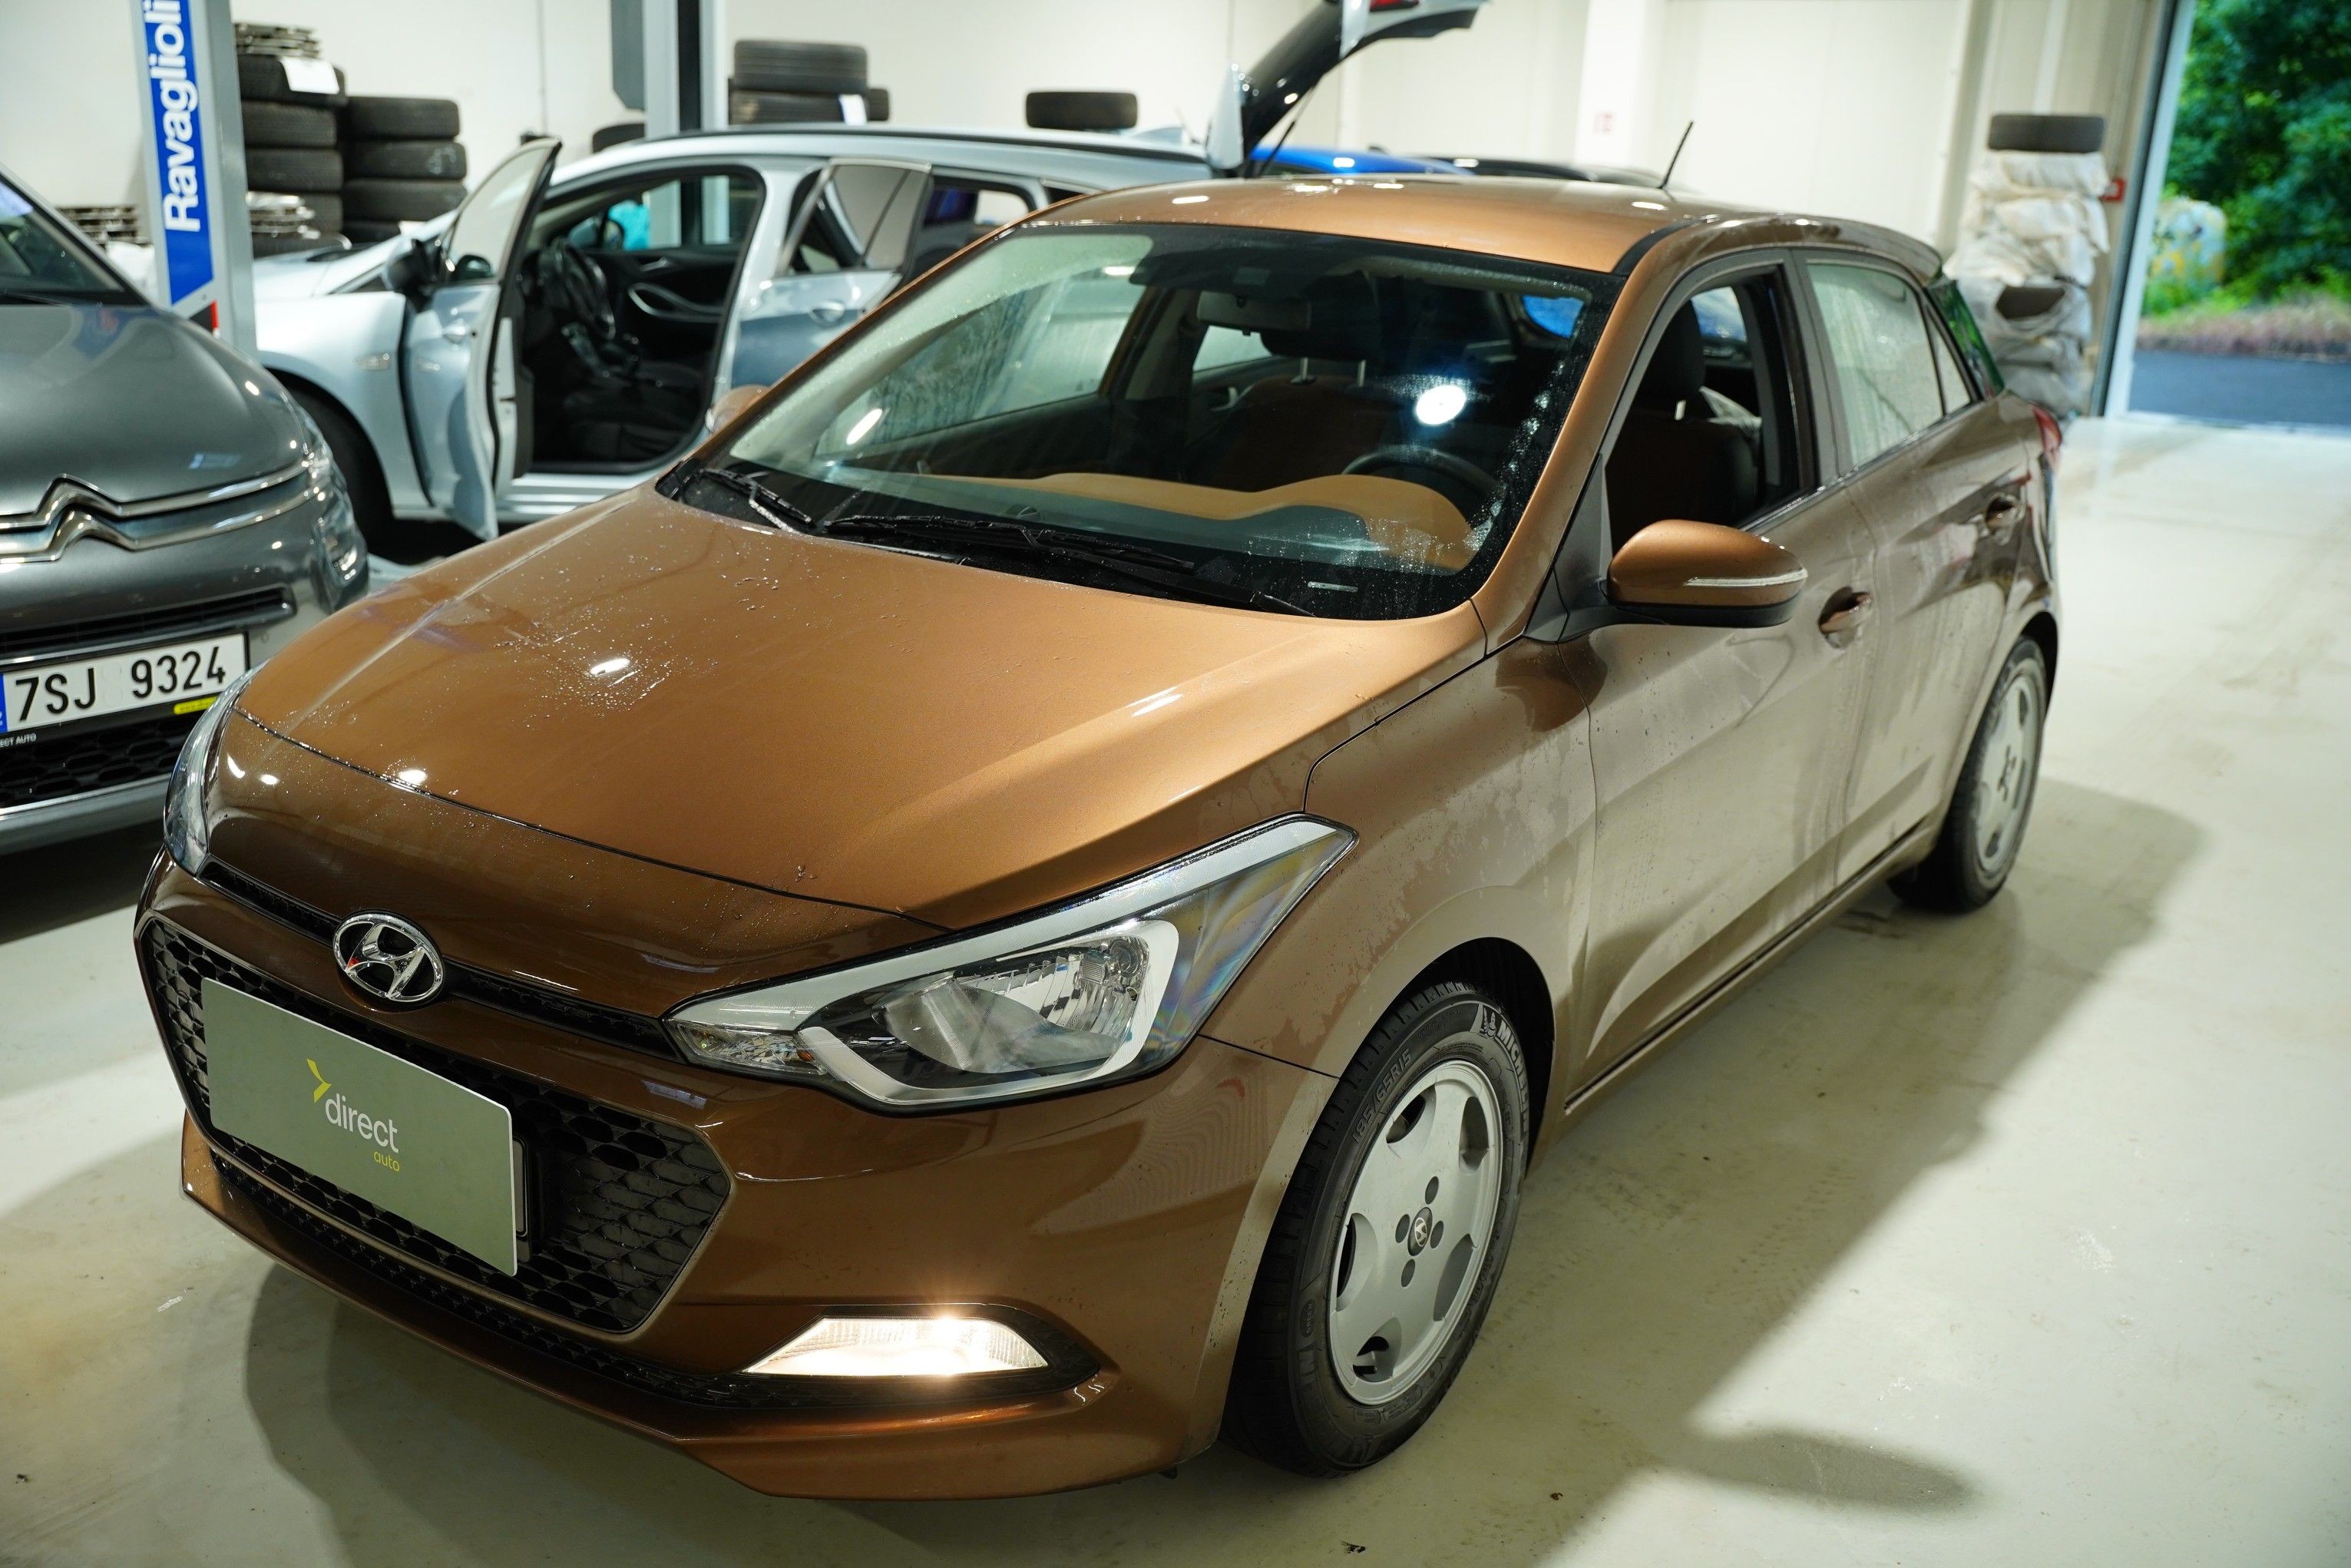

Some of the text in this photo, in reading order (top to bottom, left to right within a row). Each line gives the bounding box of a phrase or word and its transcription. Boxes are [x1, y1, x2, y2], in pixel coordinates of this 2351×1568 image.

[142, 0, 200, 232] Ravaglioli
[15, 646, 226, 722] 7SJ 9324
[15, 732, 38, 746] AUTO
[325, 1093, 399, 1153] direct
[374, 1151, 400, 1172] auto
